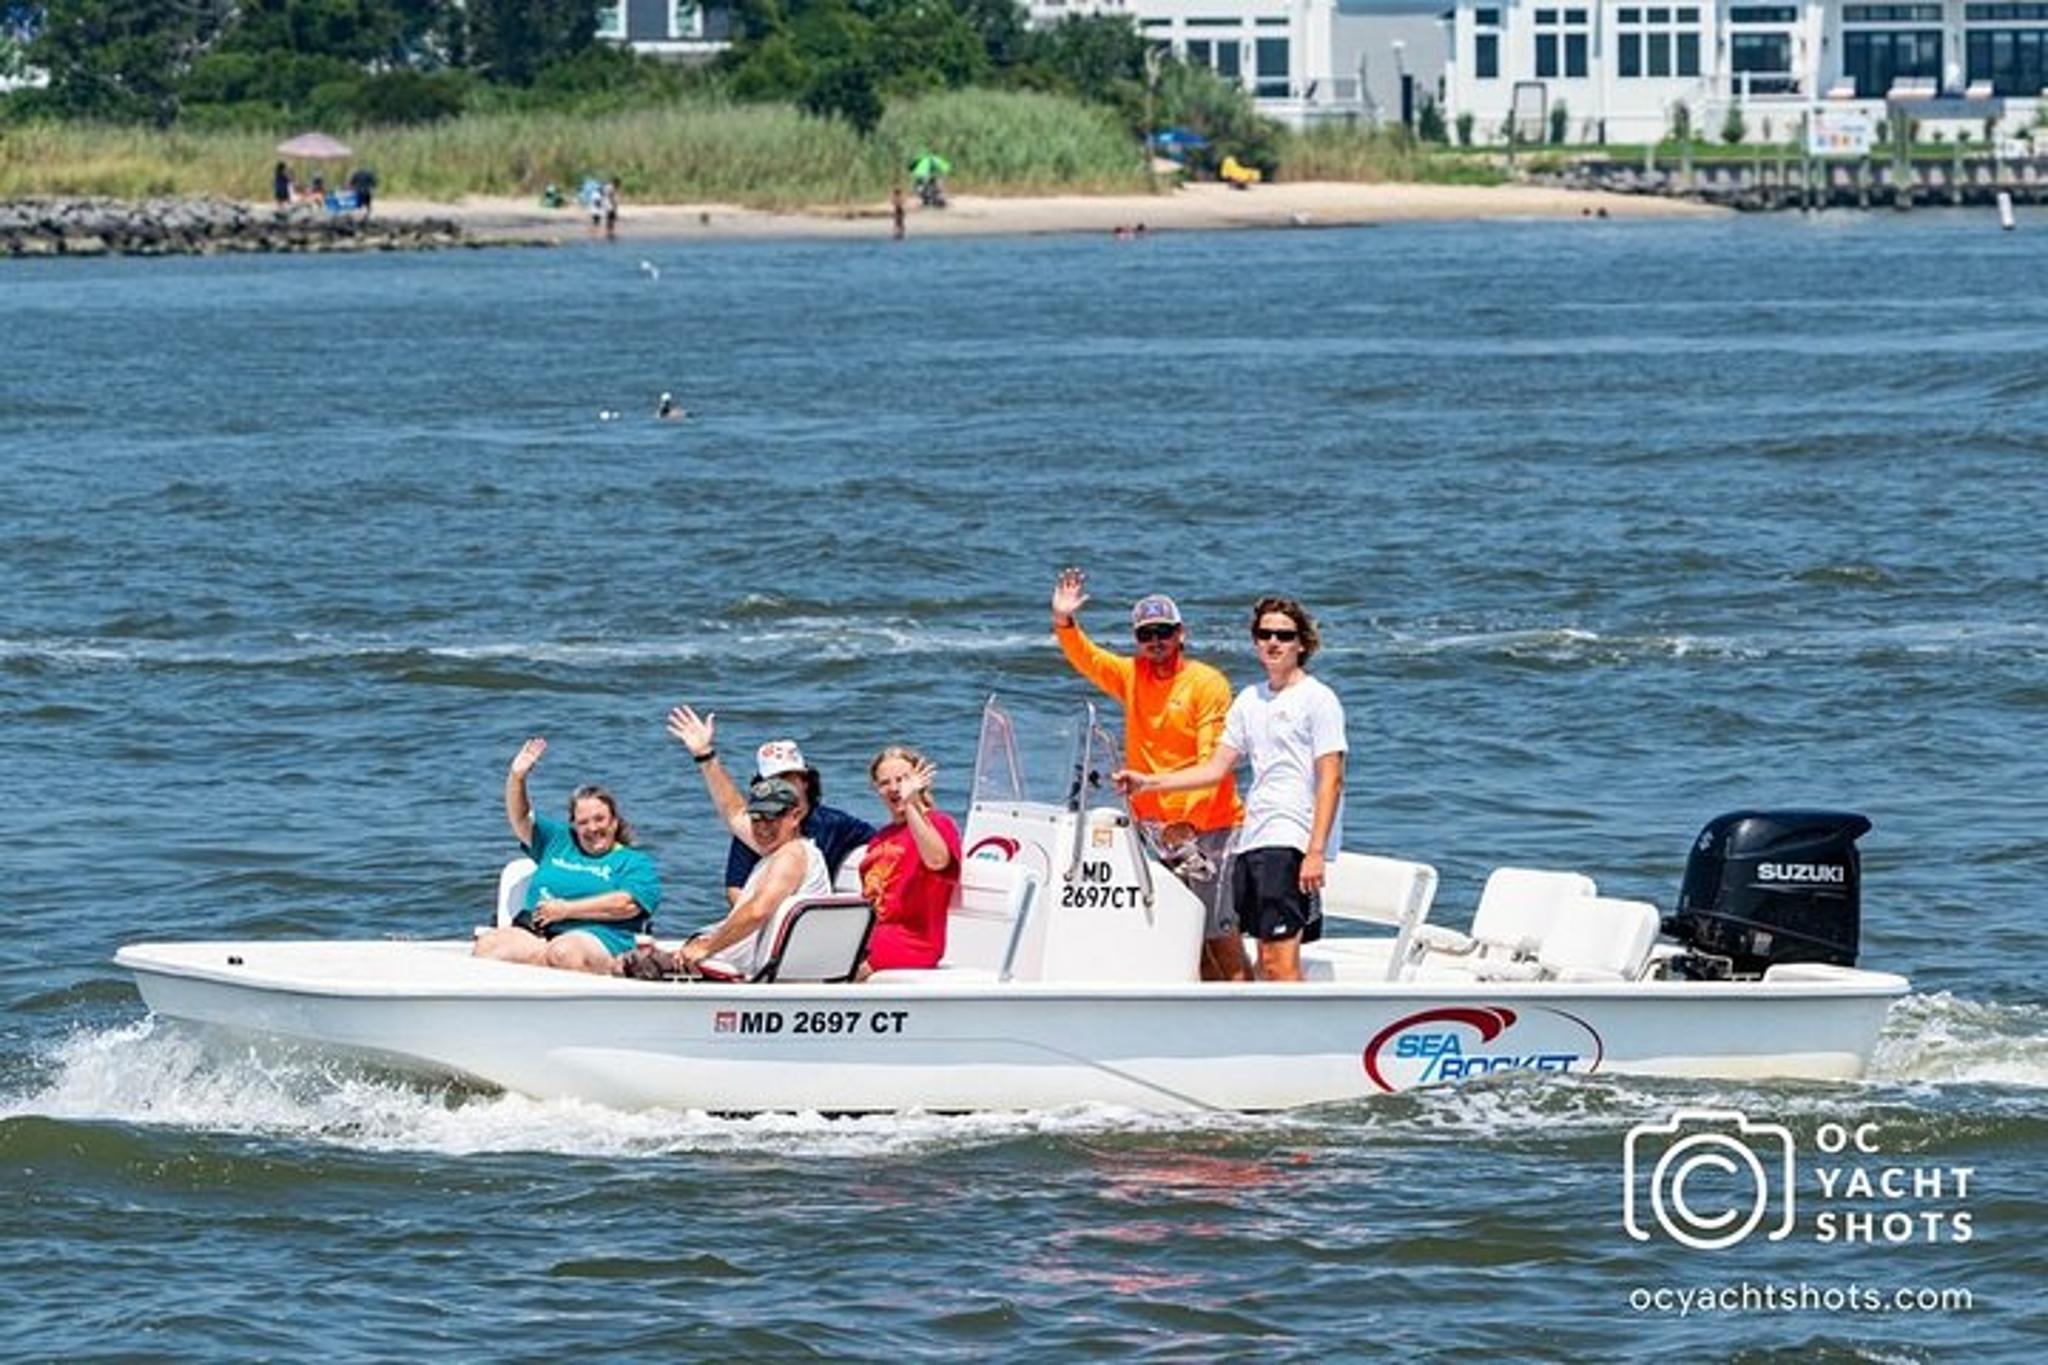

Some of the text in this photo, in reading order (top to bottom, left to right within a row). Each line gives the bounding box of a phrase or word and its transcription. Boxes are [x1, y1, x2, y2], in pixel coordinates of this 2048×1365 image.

[1082, 861, 1113, 883] MD
[1757, 862, 1845, 882] SUZUKI
[1062, 886, 1141, 909] 2697CT
[739, 1012, 783, 1033] MD
[792, 1012, 862, 1033] 2697
[870, 1012, 909, 1033] CT
